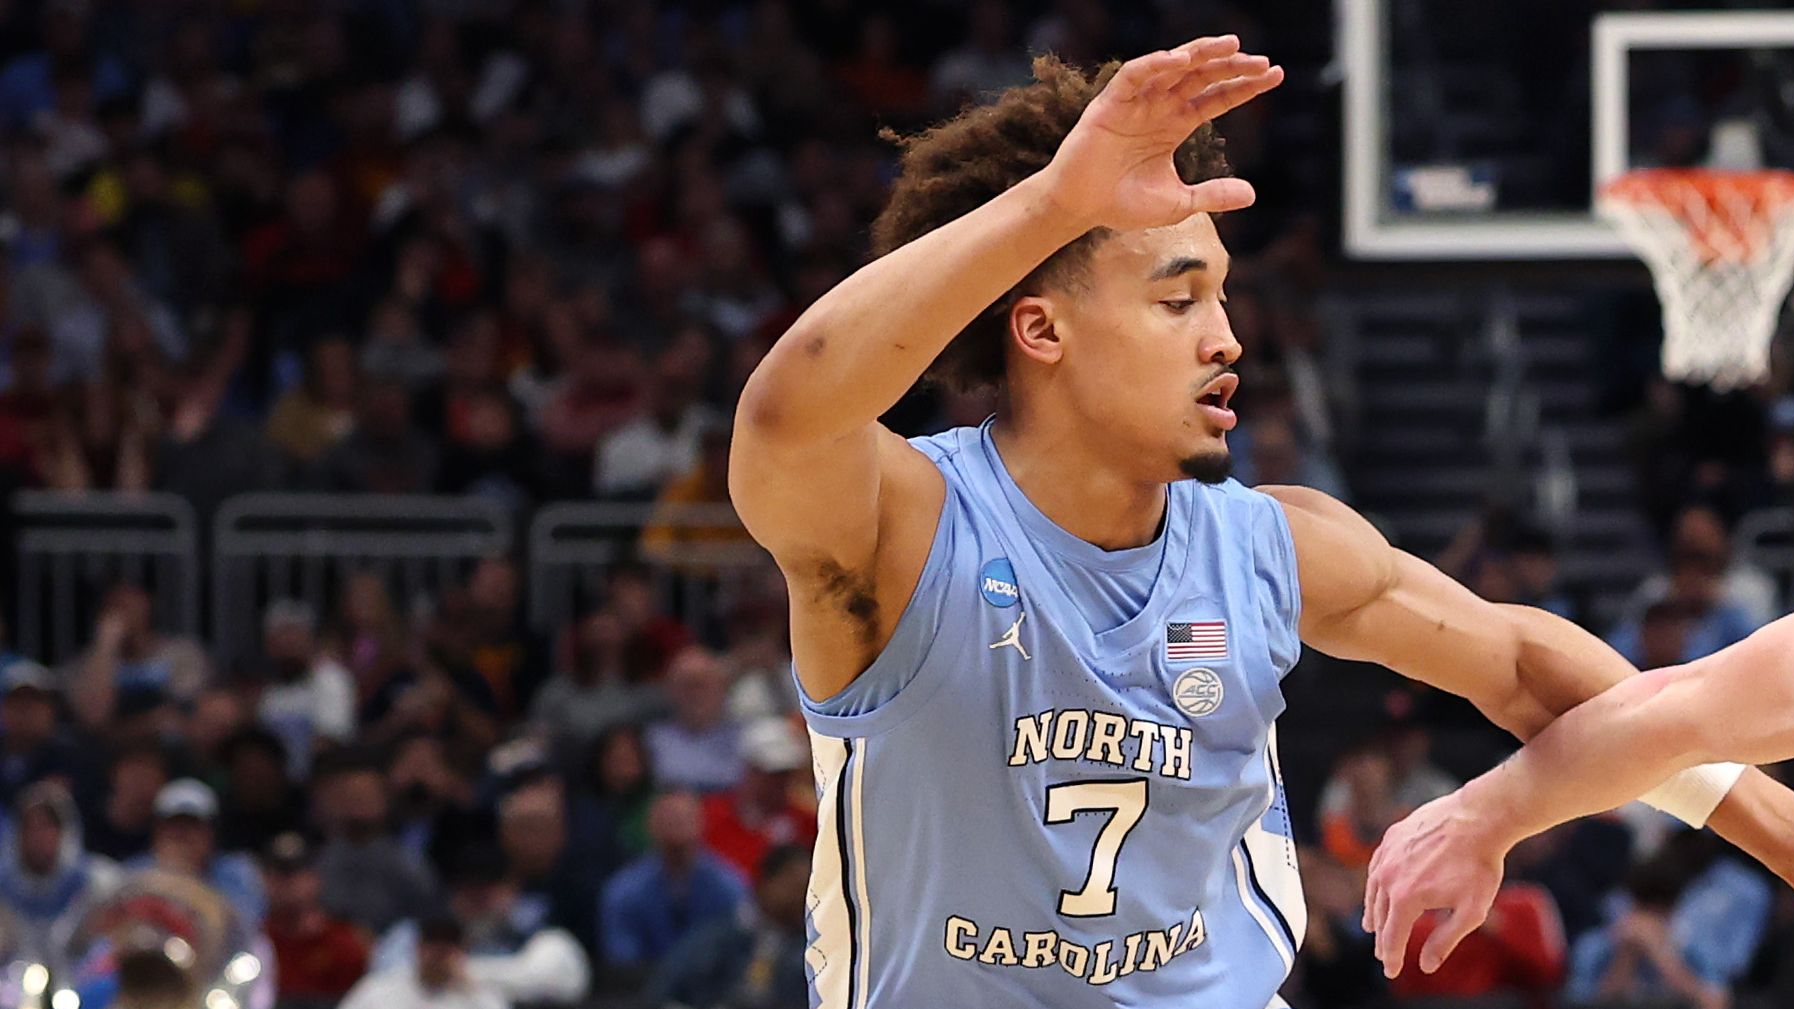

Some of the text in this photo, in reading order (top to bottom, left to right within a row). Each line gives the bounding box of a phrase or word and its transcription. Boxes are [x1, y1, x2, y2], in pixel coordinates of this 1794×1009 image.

[983, 577, 1019, 599] NCAA
[1181, 683, 1218, 696] ACC
[1008, 708, 1192, 780] NORTH
[1043, 777, 1150, 918] 7
[944, 906, 1208, 986] CAROLINA
